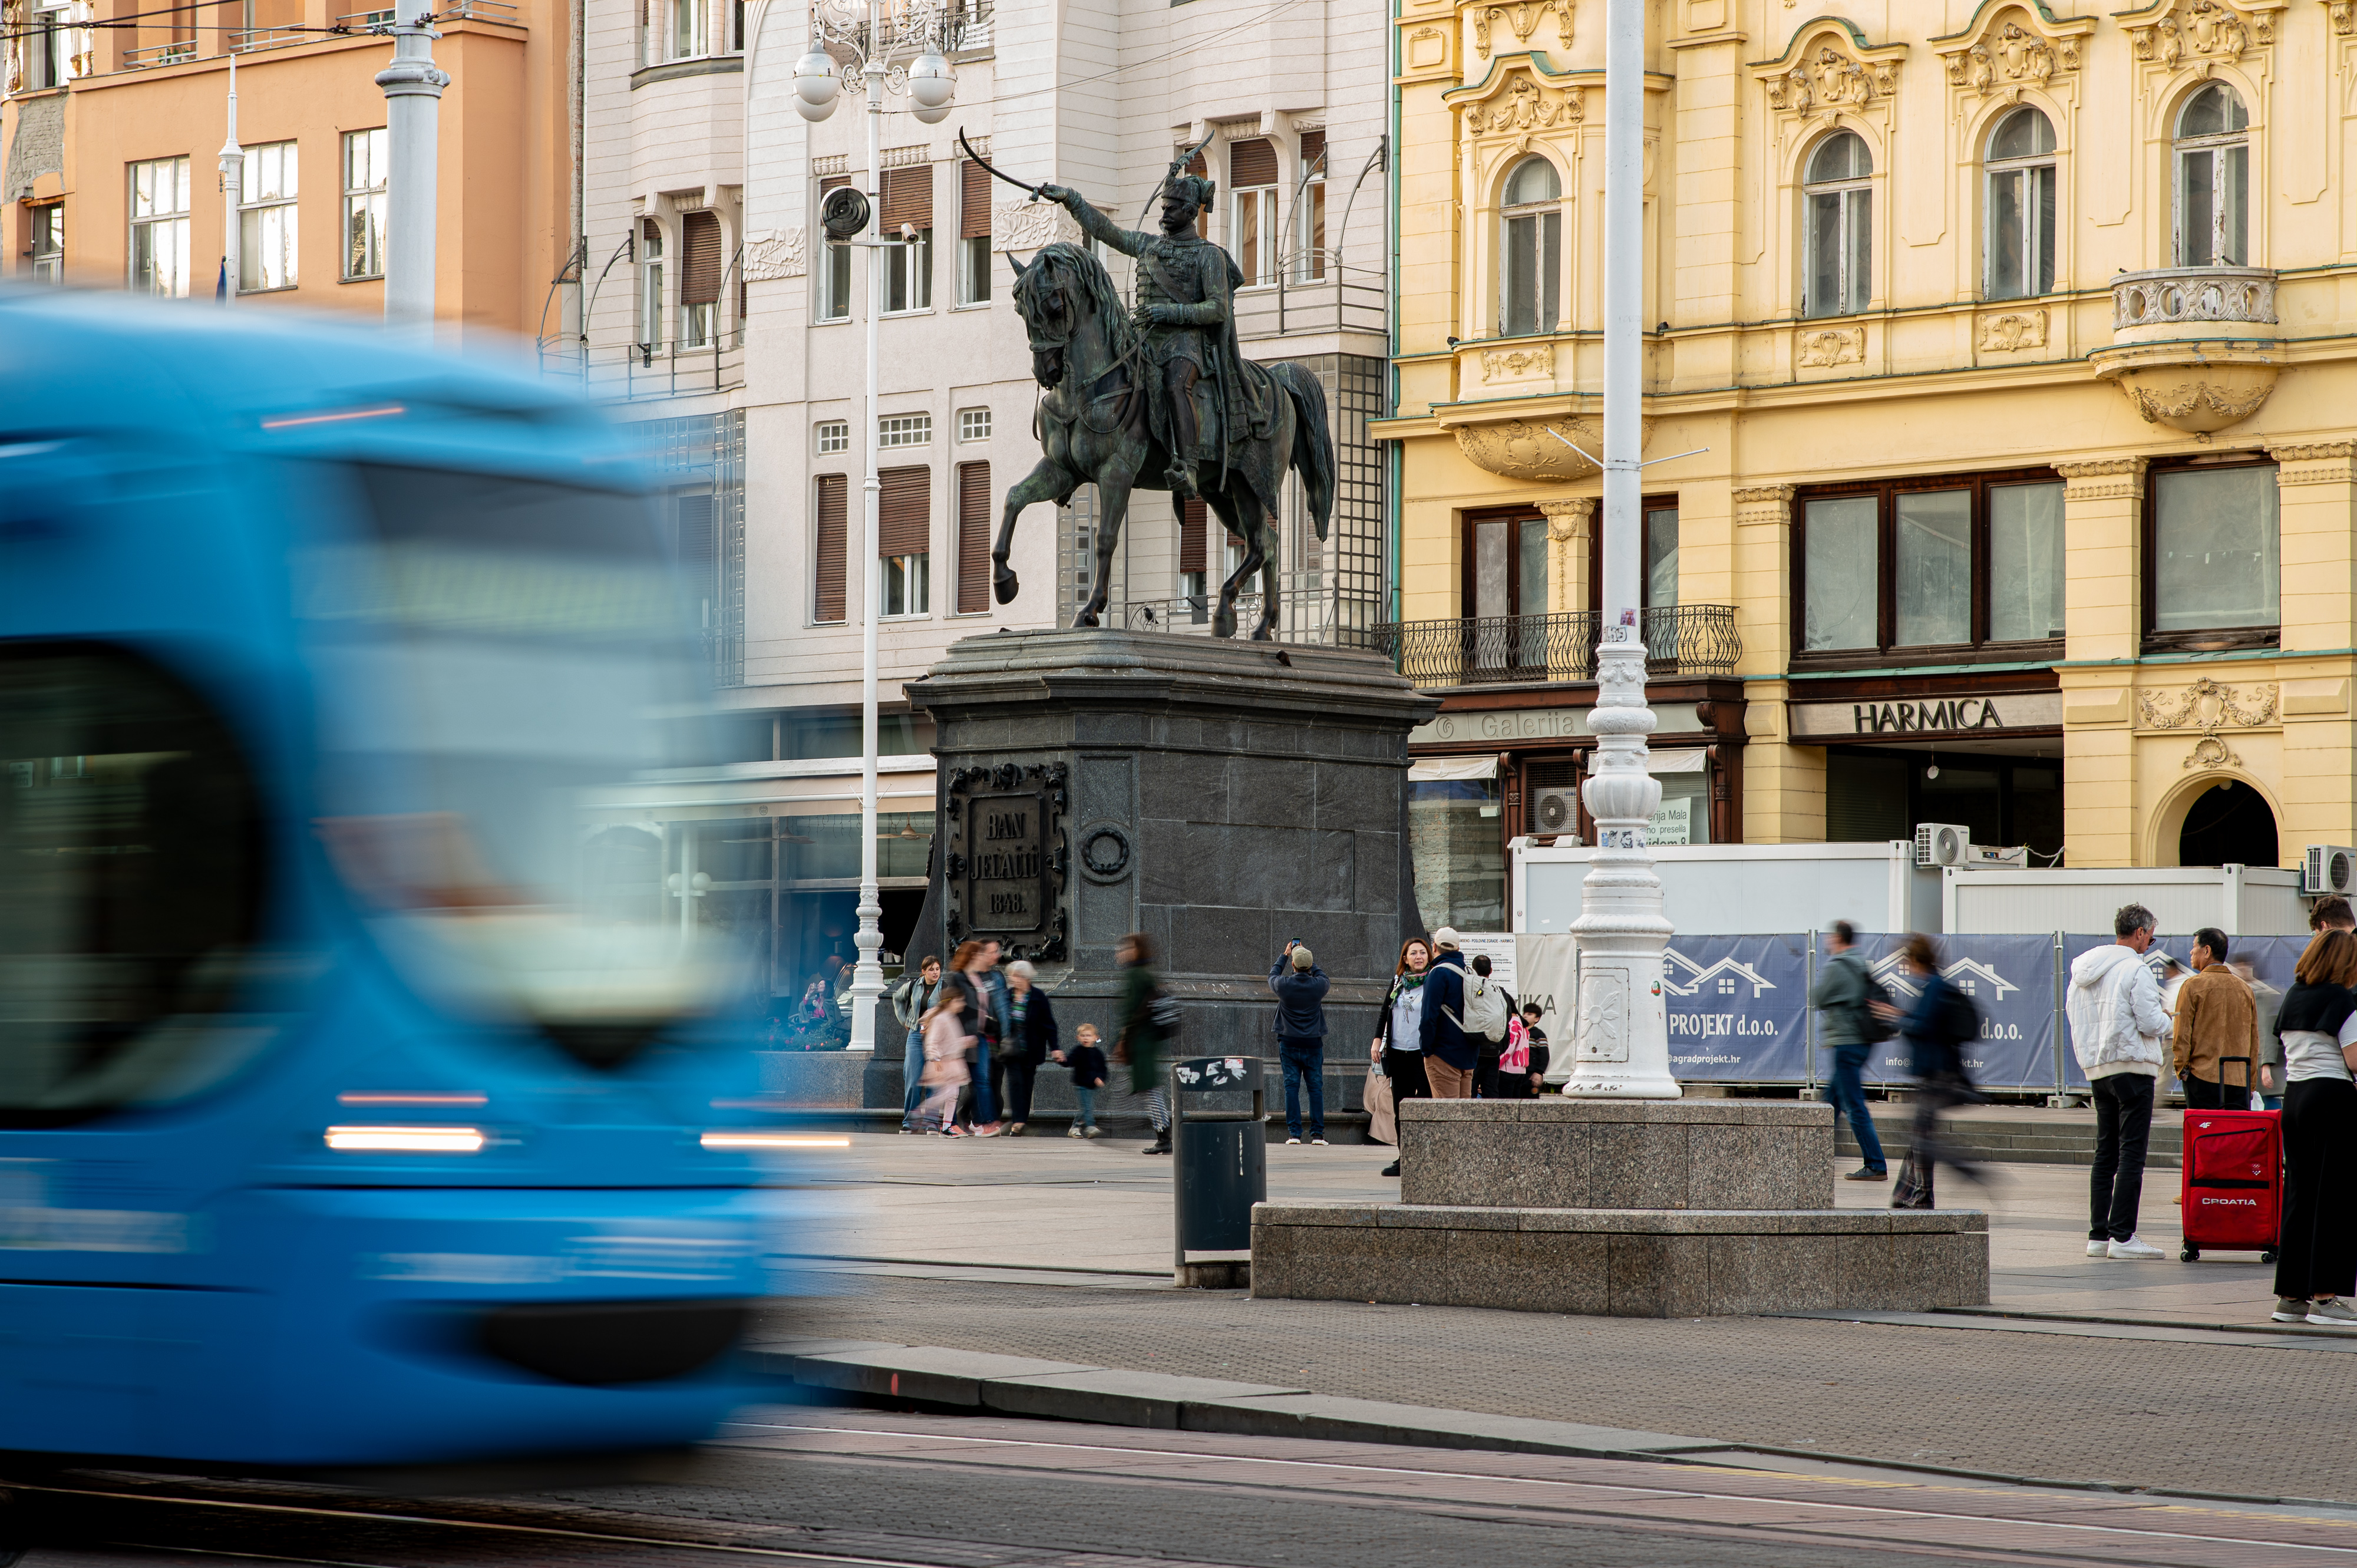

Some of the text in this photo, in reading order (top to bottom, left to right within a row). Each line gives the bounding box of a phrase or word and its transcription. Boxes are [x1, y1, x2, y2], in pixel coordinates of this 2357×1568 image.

[1481, 712, 1576, 738] Galerija
[1853, 698, 2003, 732] HARMICA
[986, 813, 1025, 839] BAN
[1668, 809, 1687, 820] Mala
[1659, 824, 1686, 835] preselila
[970, 845, 1039, 880] JELAČIĆ
[988, 893, 1026, 913] 1848.
[1669, 1014, 1778, 1039] PROJEKT d.o.o.
[1980, 1017, 2023, 1039] d.o.o.
[1668, 1054, 1741, 1064] @agradprojekt.hr
